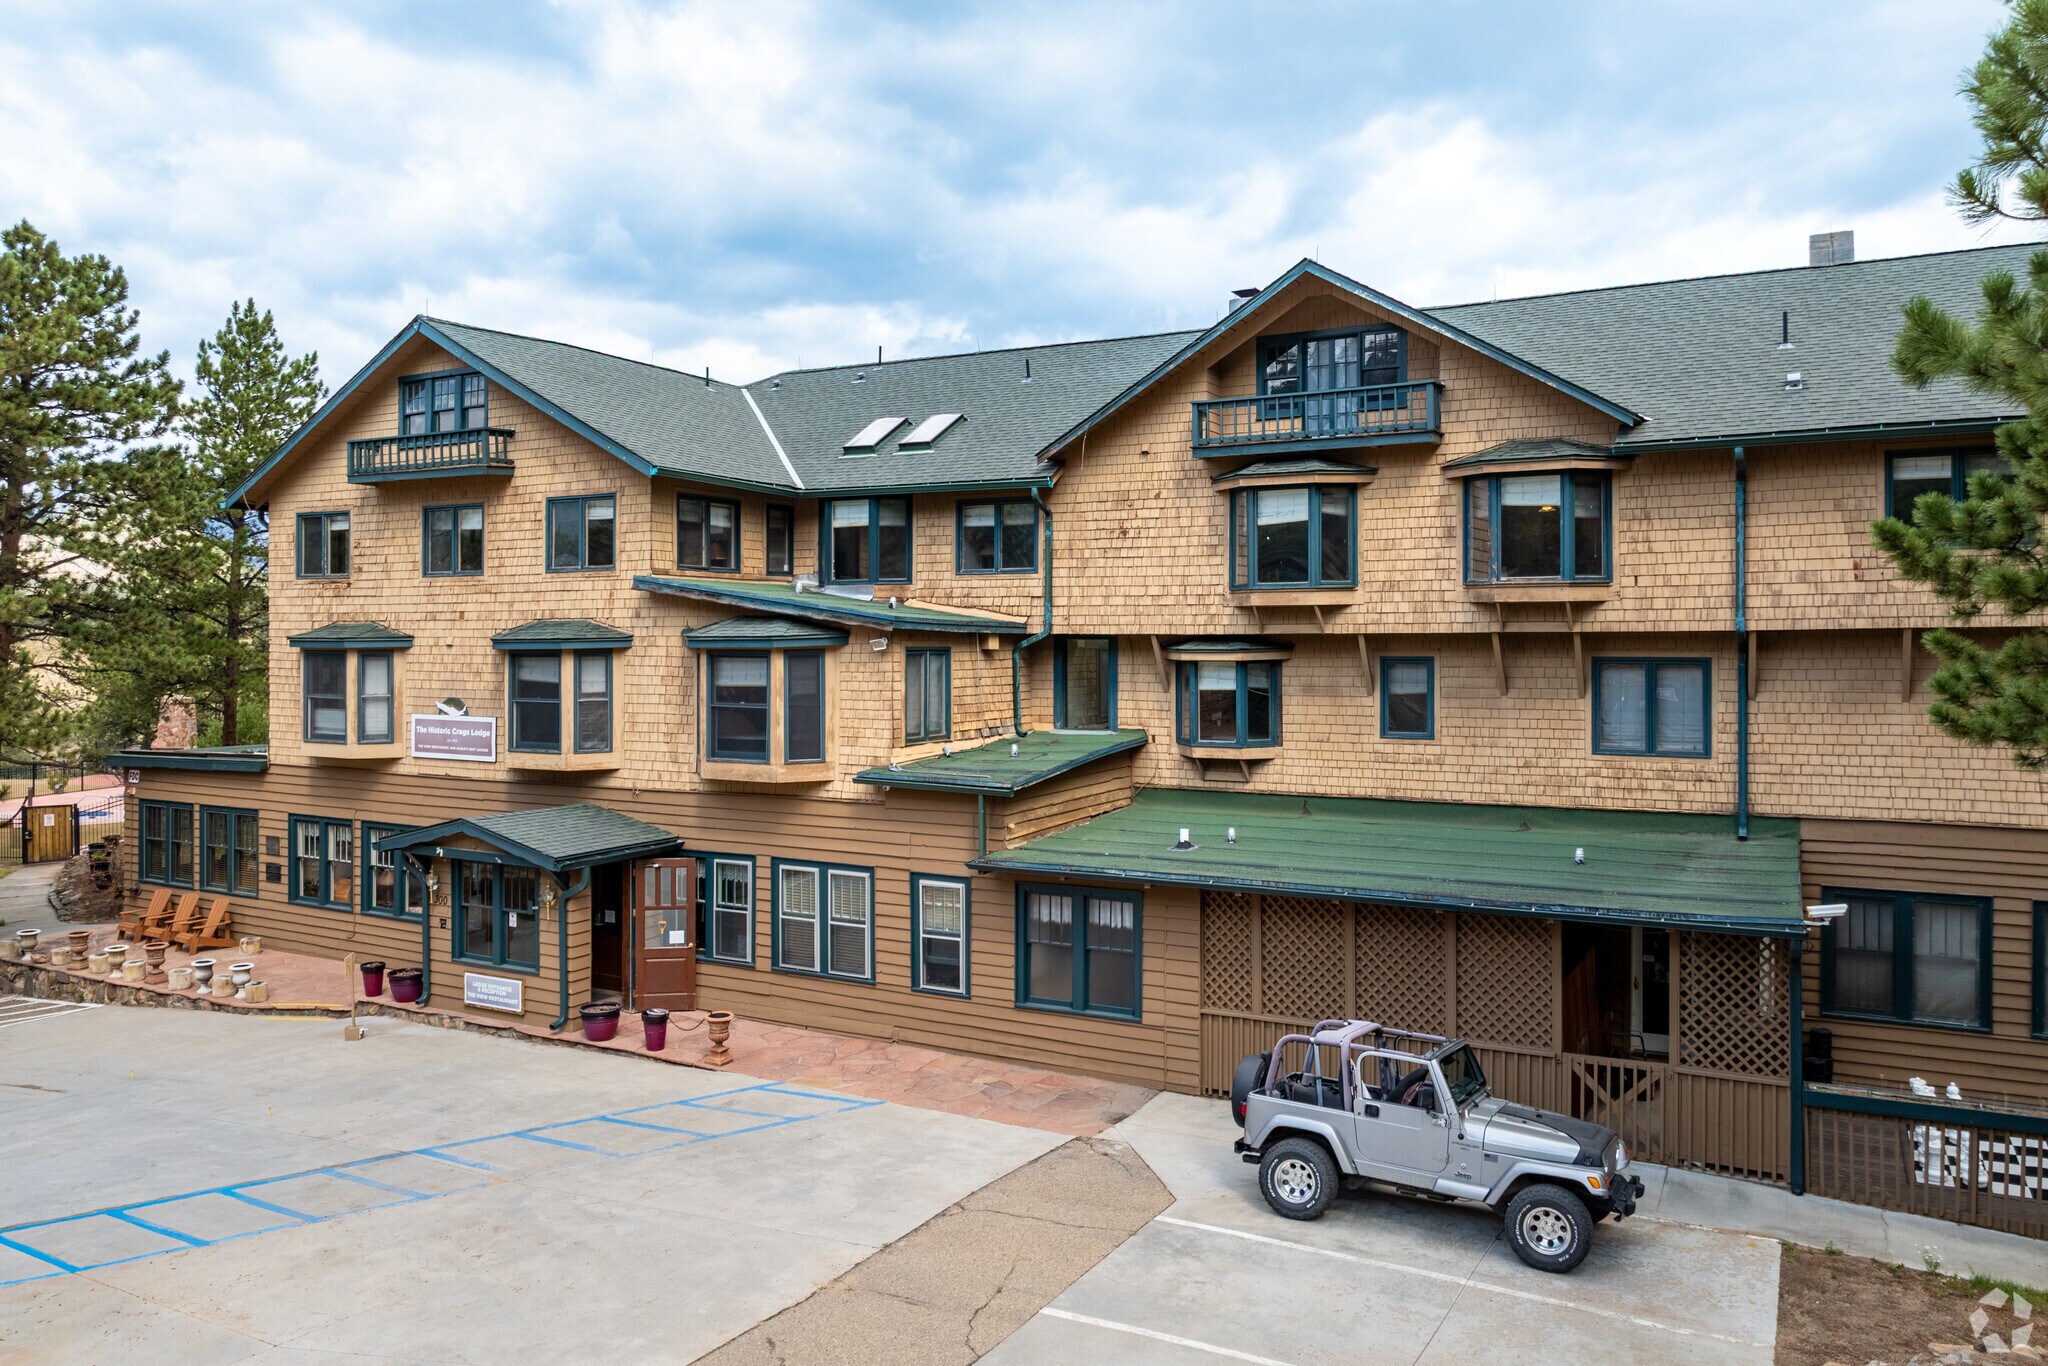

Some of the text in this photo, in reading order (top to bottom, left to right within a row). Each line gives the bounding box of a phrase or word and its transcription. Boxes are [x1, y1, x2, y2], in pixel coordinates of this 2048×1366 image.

[452, 728, 470, 736] Crags
[471, 729, 490, 737] Lodge
[434, 895, 448, 905] 300
[482, 988, 507, 996] RECEPTION
[488, 984, 512, 992] ENTRANCE
[489, 996, 518, 1004] RESTAURANT
[1454, 1171, 1472, 1180] Jeep
